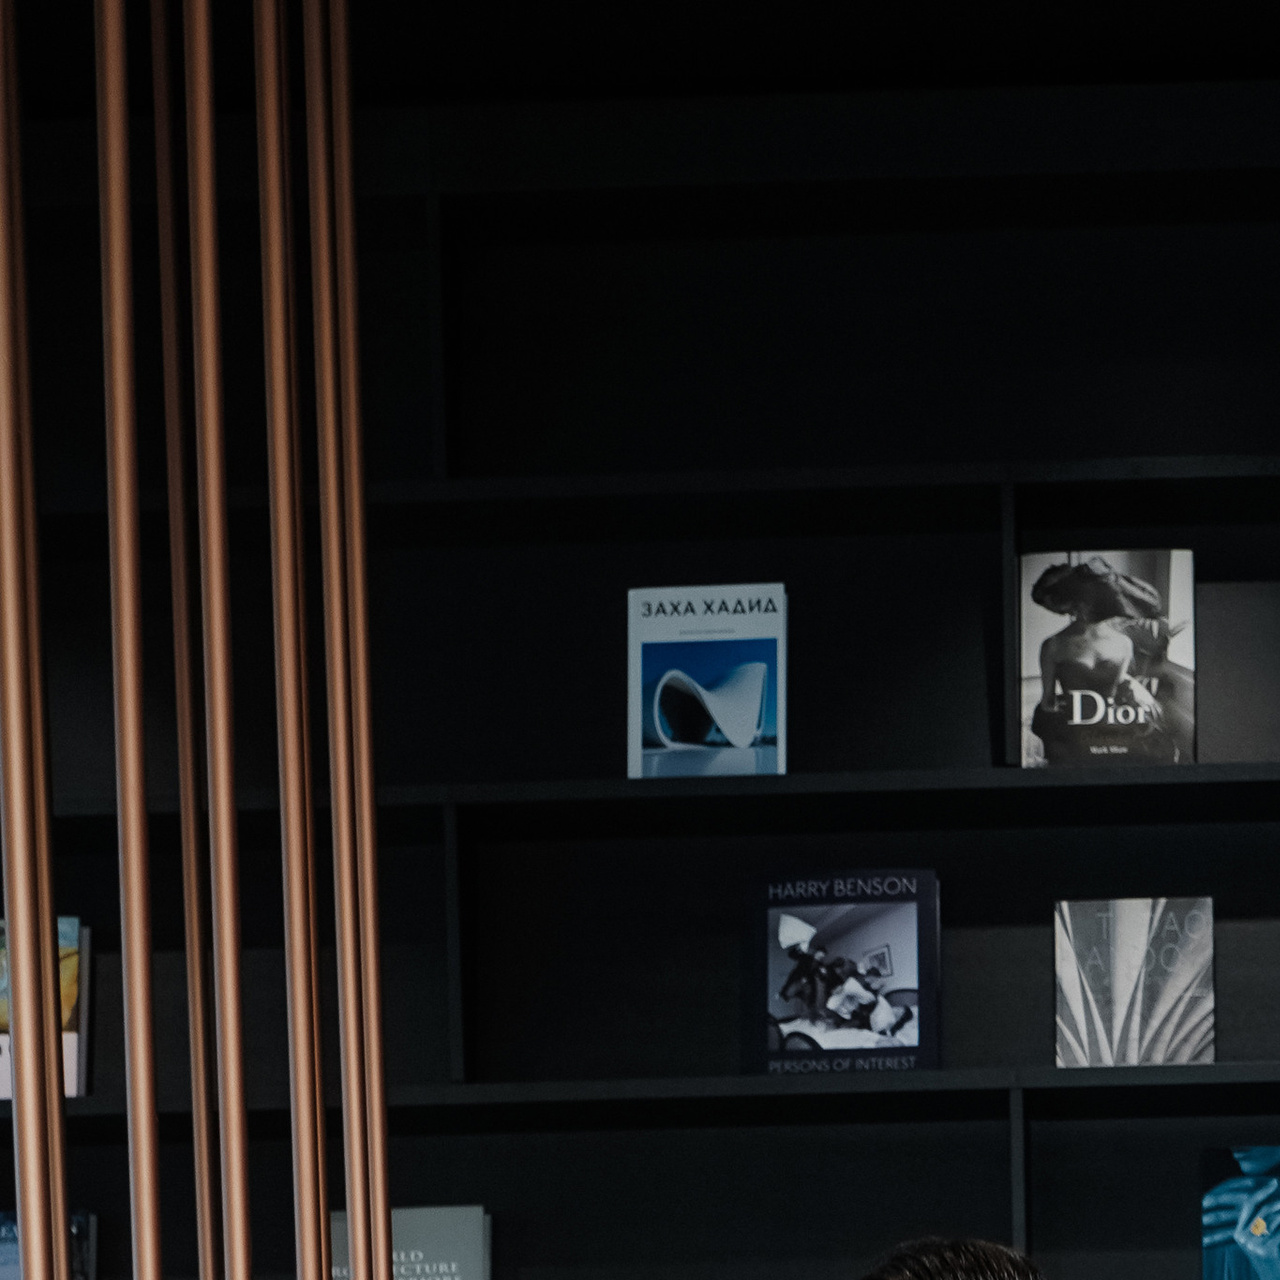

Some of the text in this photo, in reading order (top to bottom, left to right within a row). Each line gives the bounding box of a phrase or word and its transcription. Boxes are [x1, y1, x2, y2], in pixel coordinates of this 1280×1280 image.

[641, 598, 778, 618] ЗАХА ХАДИД
[1067, 689, 1150, 726] Dior
[768, 876, 917, 899] HARRY BENSON
